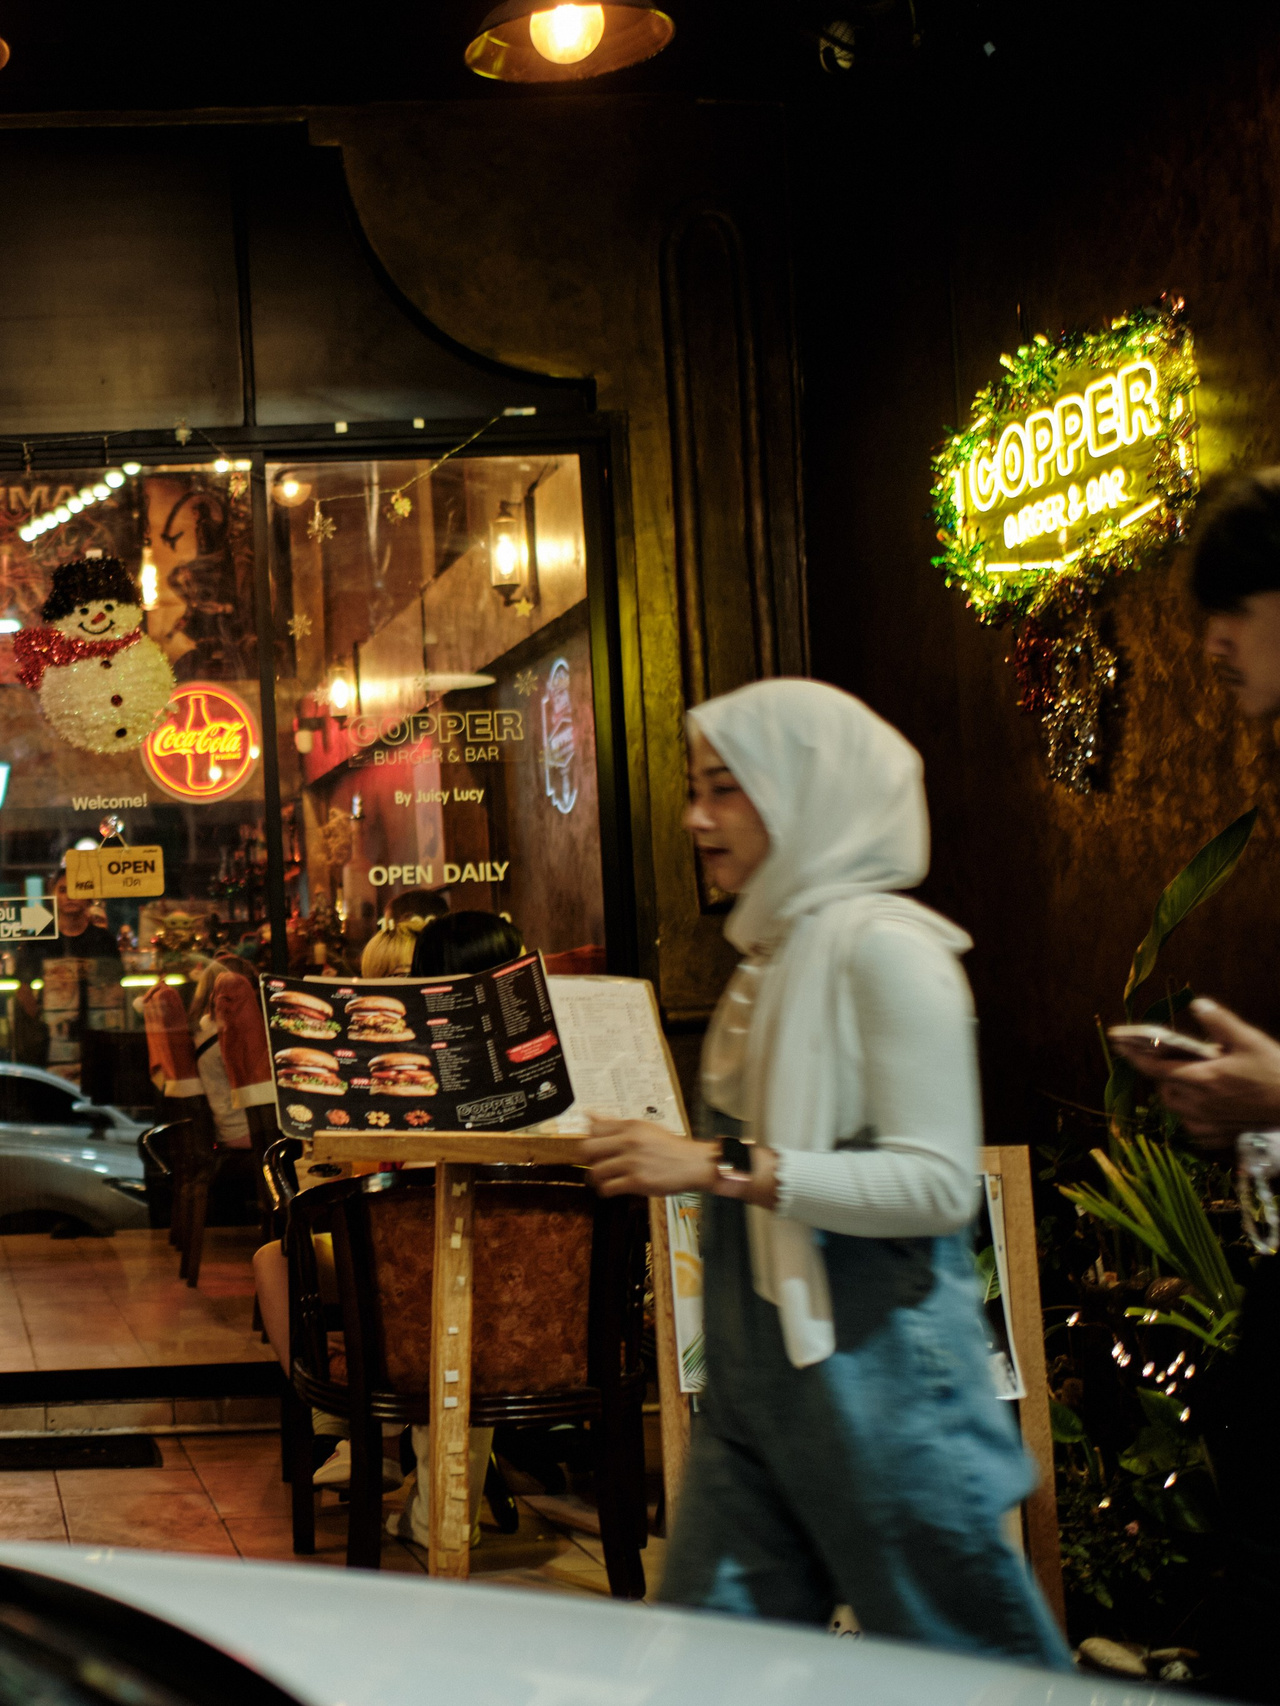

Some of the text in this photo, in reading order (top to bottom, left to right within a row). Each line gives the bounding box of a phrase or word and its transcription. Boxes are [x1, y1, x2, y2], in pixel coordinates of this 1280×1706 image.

[969, 357, 1163, 512] COPPER
[1085, 465, 1129, 513] BAR
[153, 721, 245, 758] Coca-Cola
[347, 709, 525, 747] COPPER
[373, 746, 500, 766] BURGER & BAR
[72, 793, 148, 811] Welcome!
[394, 788, 485, 807] By Juicy Lucy
[107, 860, 156, 876] OPEN
[368, 862, 509, 887] OPEN DAILY
